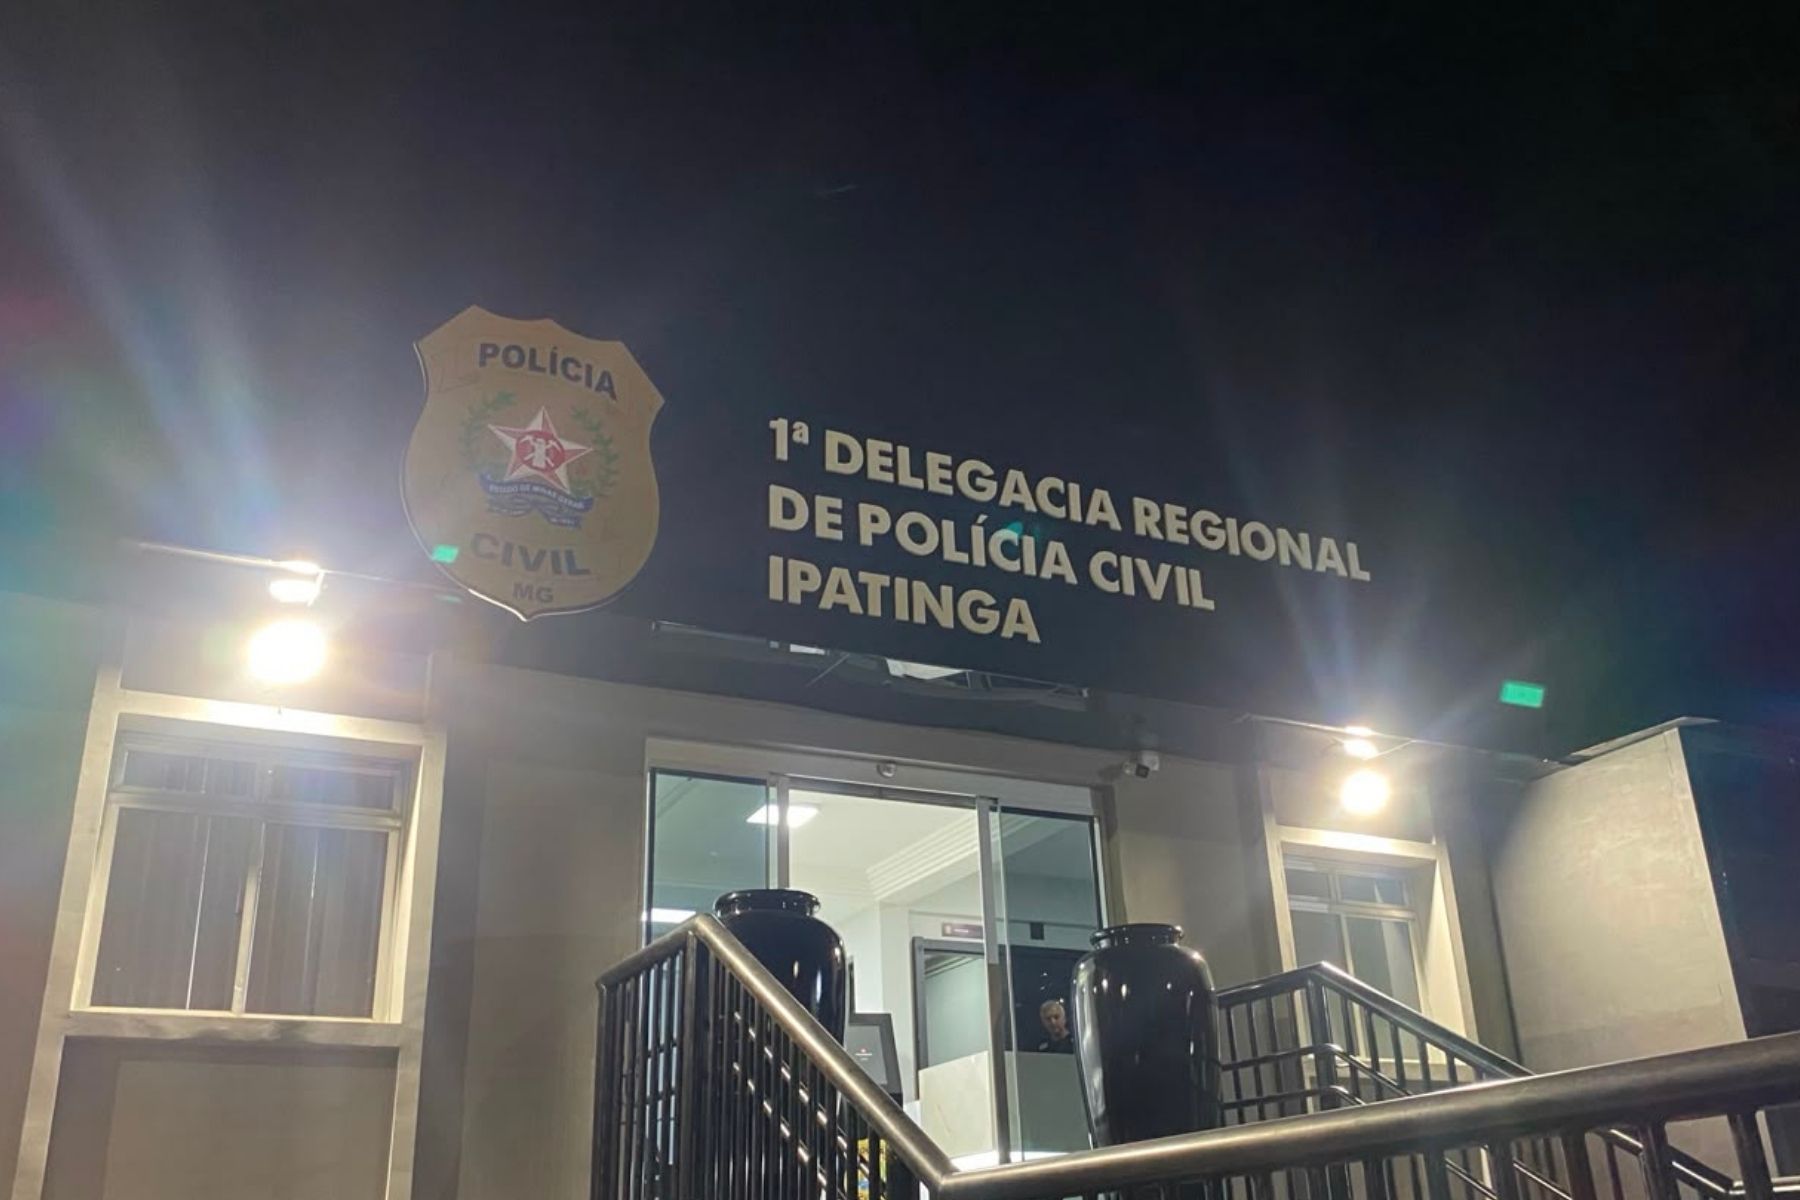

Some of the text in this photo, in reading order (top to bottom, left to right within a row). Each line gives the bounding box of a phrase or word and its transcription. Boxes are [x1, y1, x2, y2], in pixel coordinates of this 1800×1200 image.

[478, 342, 618, 401] POLÍCIA
[768, 417, 1372, 582] 1ª DELEGACIA REGIONAL
[470, 532, 592, 577] CIVIL
[768, 484, 1216, 611] DE POLÍCIA CIVIL
[512, 581, 554, 604] MG
[768, 555, 1041, 645] IPATINGA
